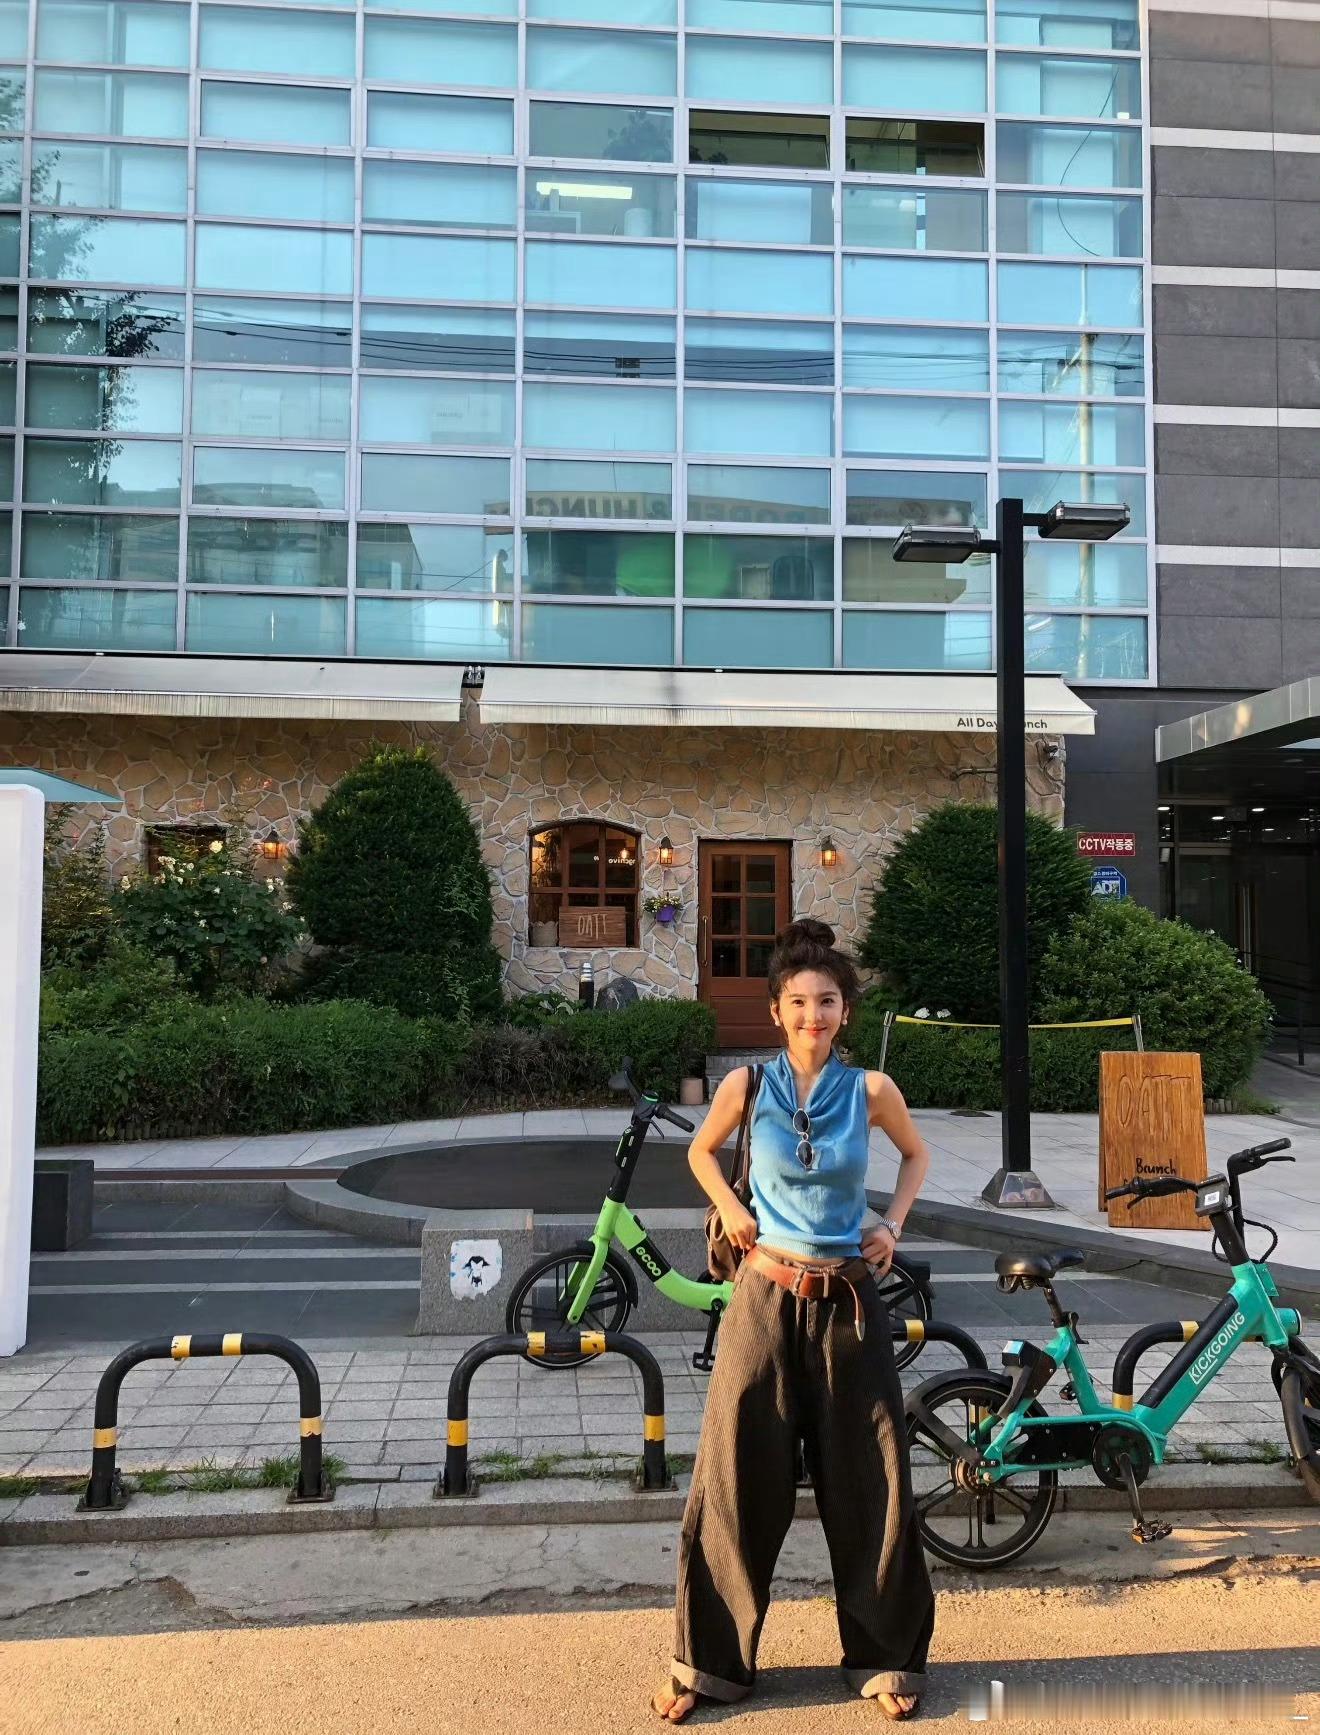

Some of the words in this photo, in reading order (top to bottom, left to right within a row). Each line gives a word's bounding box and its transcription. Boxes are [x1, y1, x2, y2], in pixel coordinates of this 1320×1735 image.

[957, 717, 973, 727] All
[1078, 837, 1134, 851] CCTV작동중
[1135, 1157, 1177, 1175] Brunch
[635, 1246, 662, 1277] GCOO
[1188, 1311, 1246, 1382] KICKGOING
